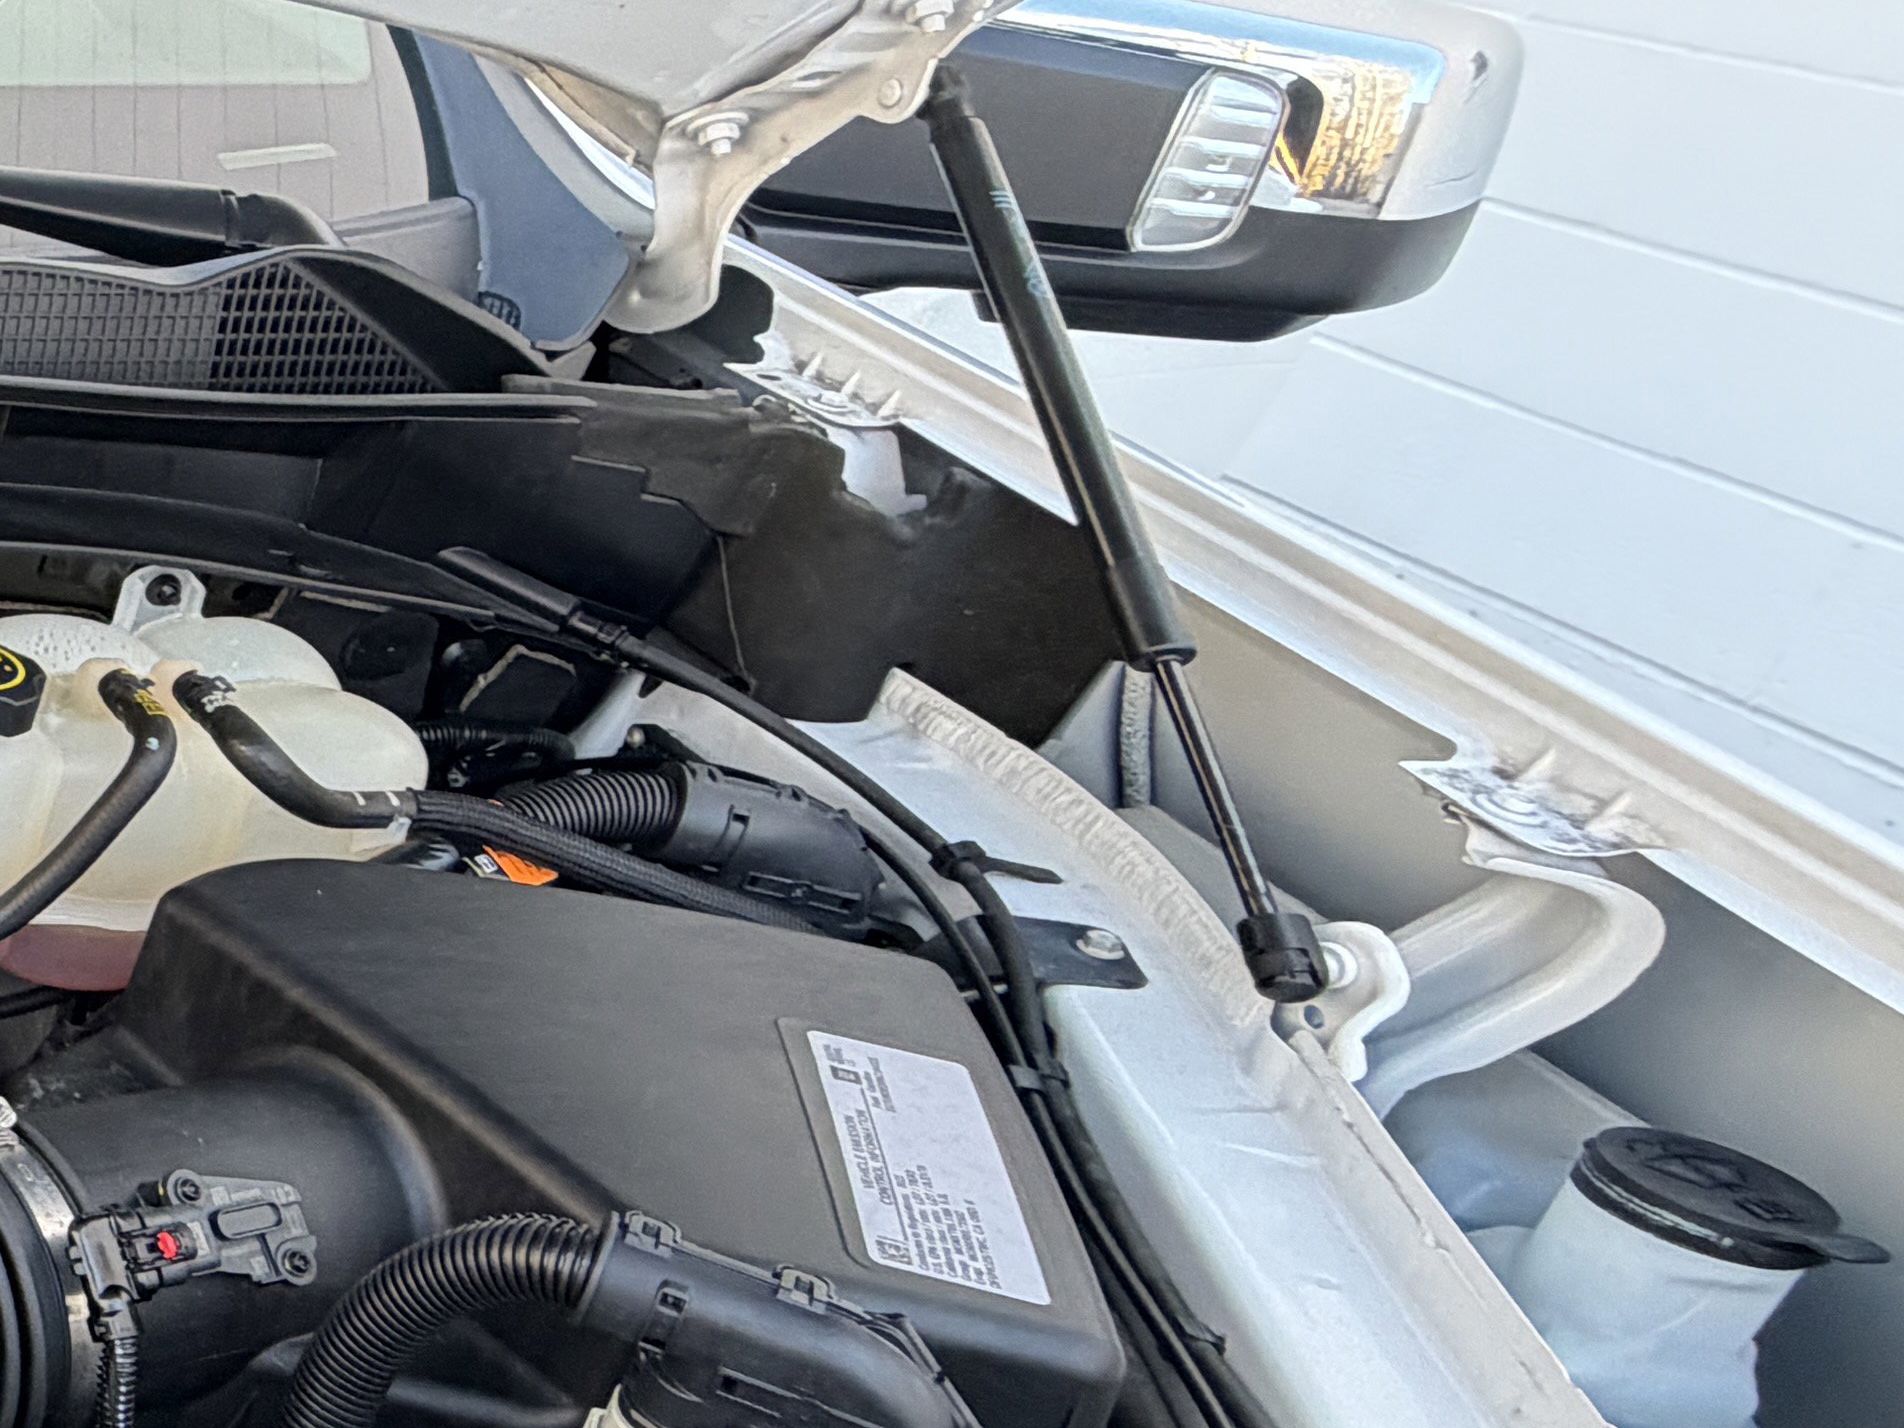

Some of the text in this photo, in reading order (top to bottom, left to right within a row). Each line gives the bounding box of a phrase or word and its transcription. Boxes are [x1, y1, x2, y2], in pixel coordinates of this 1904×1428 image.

[852, 1152, 875, 1190] VEHICLE
[854, 1108, 894, 1206] CONTROL INFORMATION
